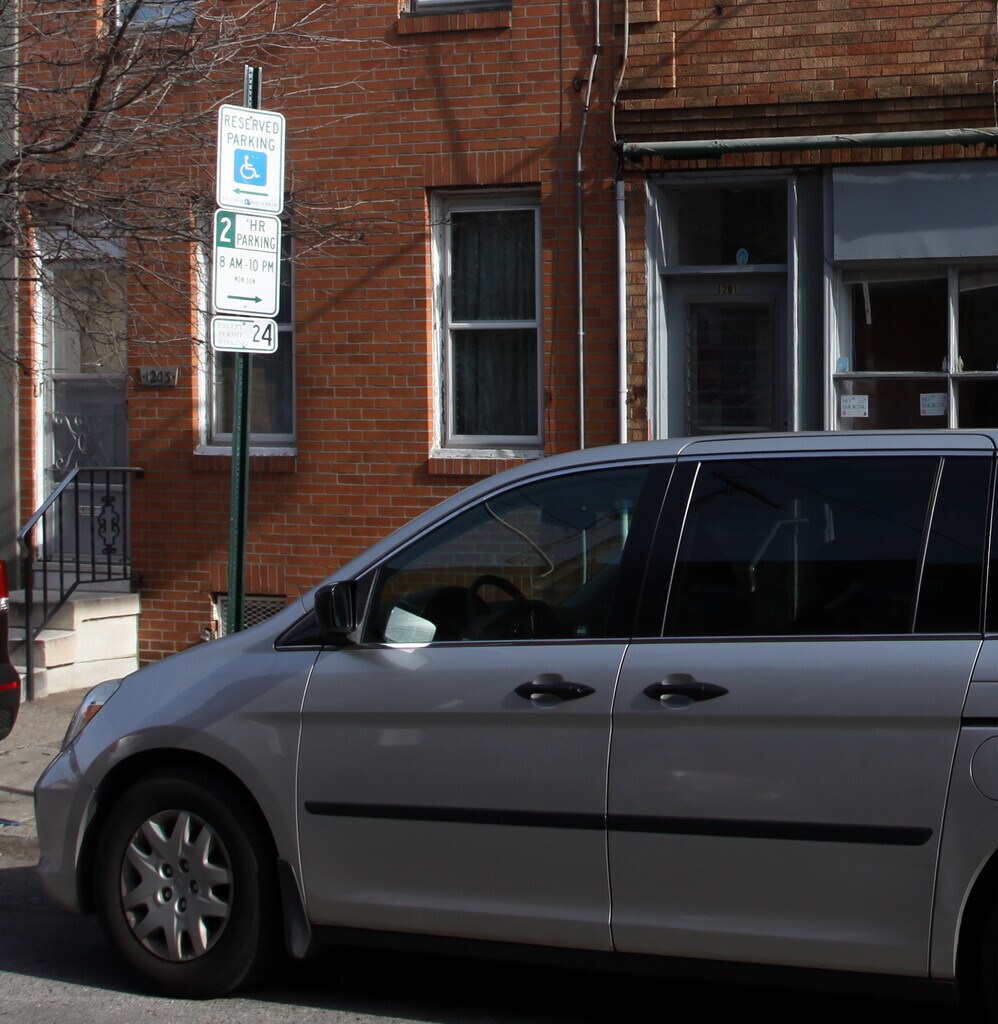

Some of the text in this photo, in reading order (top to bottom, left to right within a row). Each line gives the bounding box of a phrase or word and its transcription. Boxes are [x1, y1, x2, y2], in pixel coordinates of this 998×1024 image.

[224, 114, 279, 135] RESERVED
[227, 132, 275, 151] PARKING
[219, 216, 266, 243] 2 HR
[237, 233, 276, 250] PARKING
[219, 255, 226, 268] 8
[229, 256, 243, 270] AM
[262, 260, 274, 273] PM
[252, 323, 273, 347] 24
